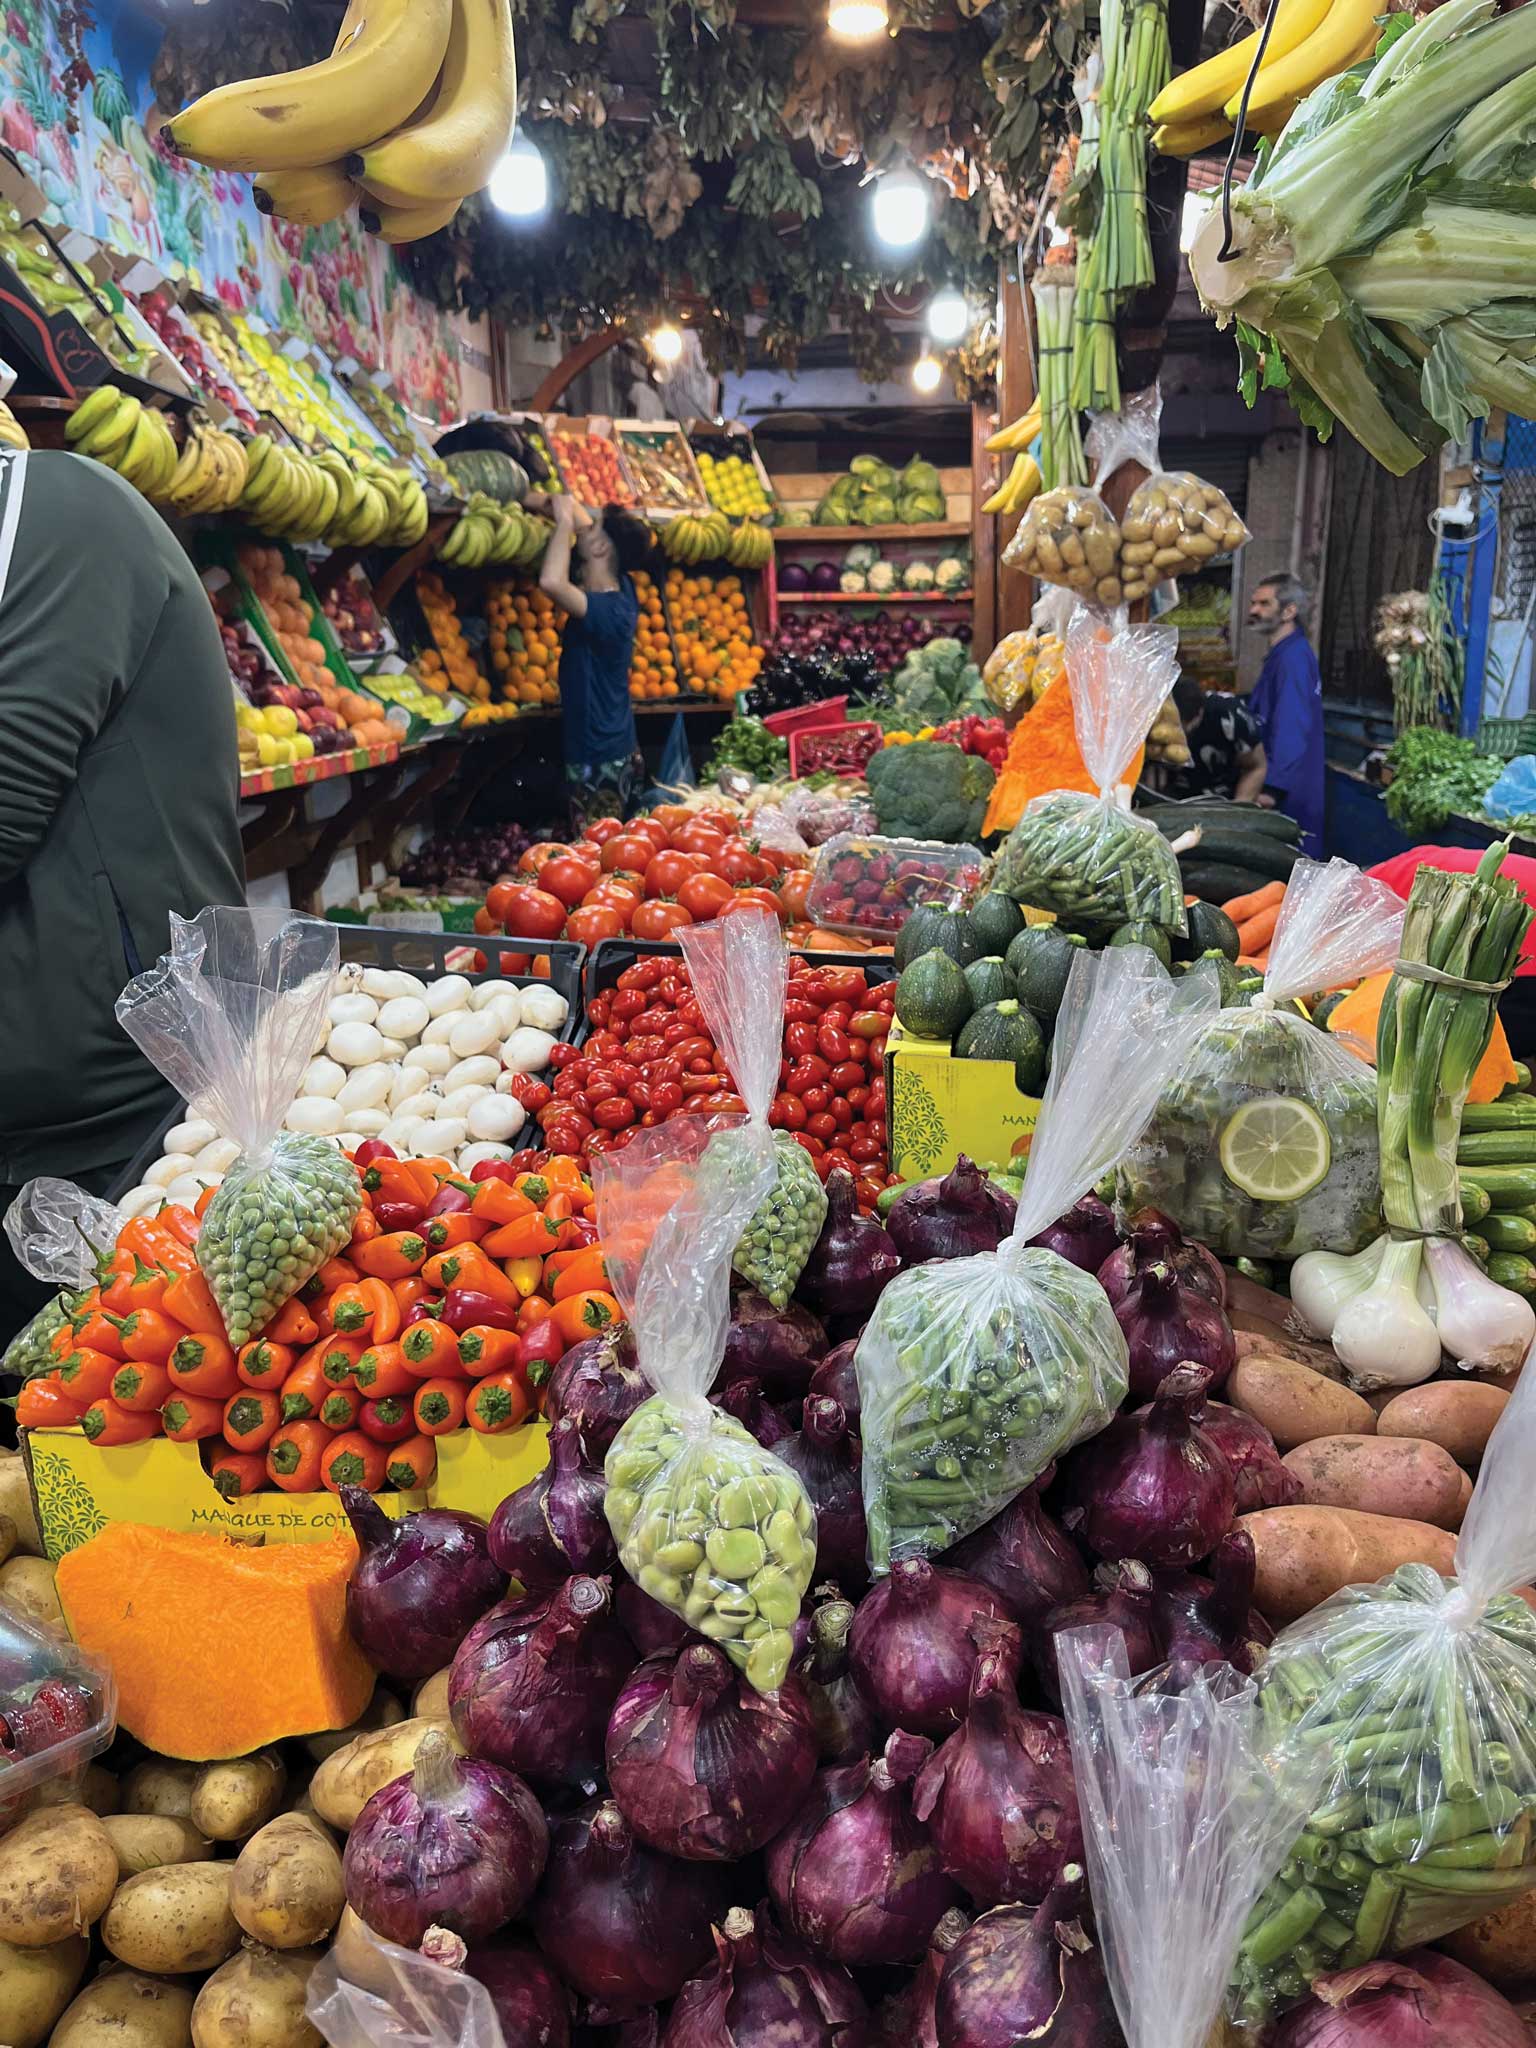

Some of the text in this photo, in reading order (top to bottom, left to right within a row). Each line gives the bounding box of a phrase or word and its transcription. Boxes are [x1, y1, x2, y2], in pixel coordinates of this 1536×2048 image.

[1002, 1114, 1037, 1126] MAN
[191, 1508, 352, 1528] MANGUE DE CÔT
